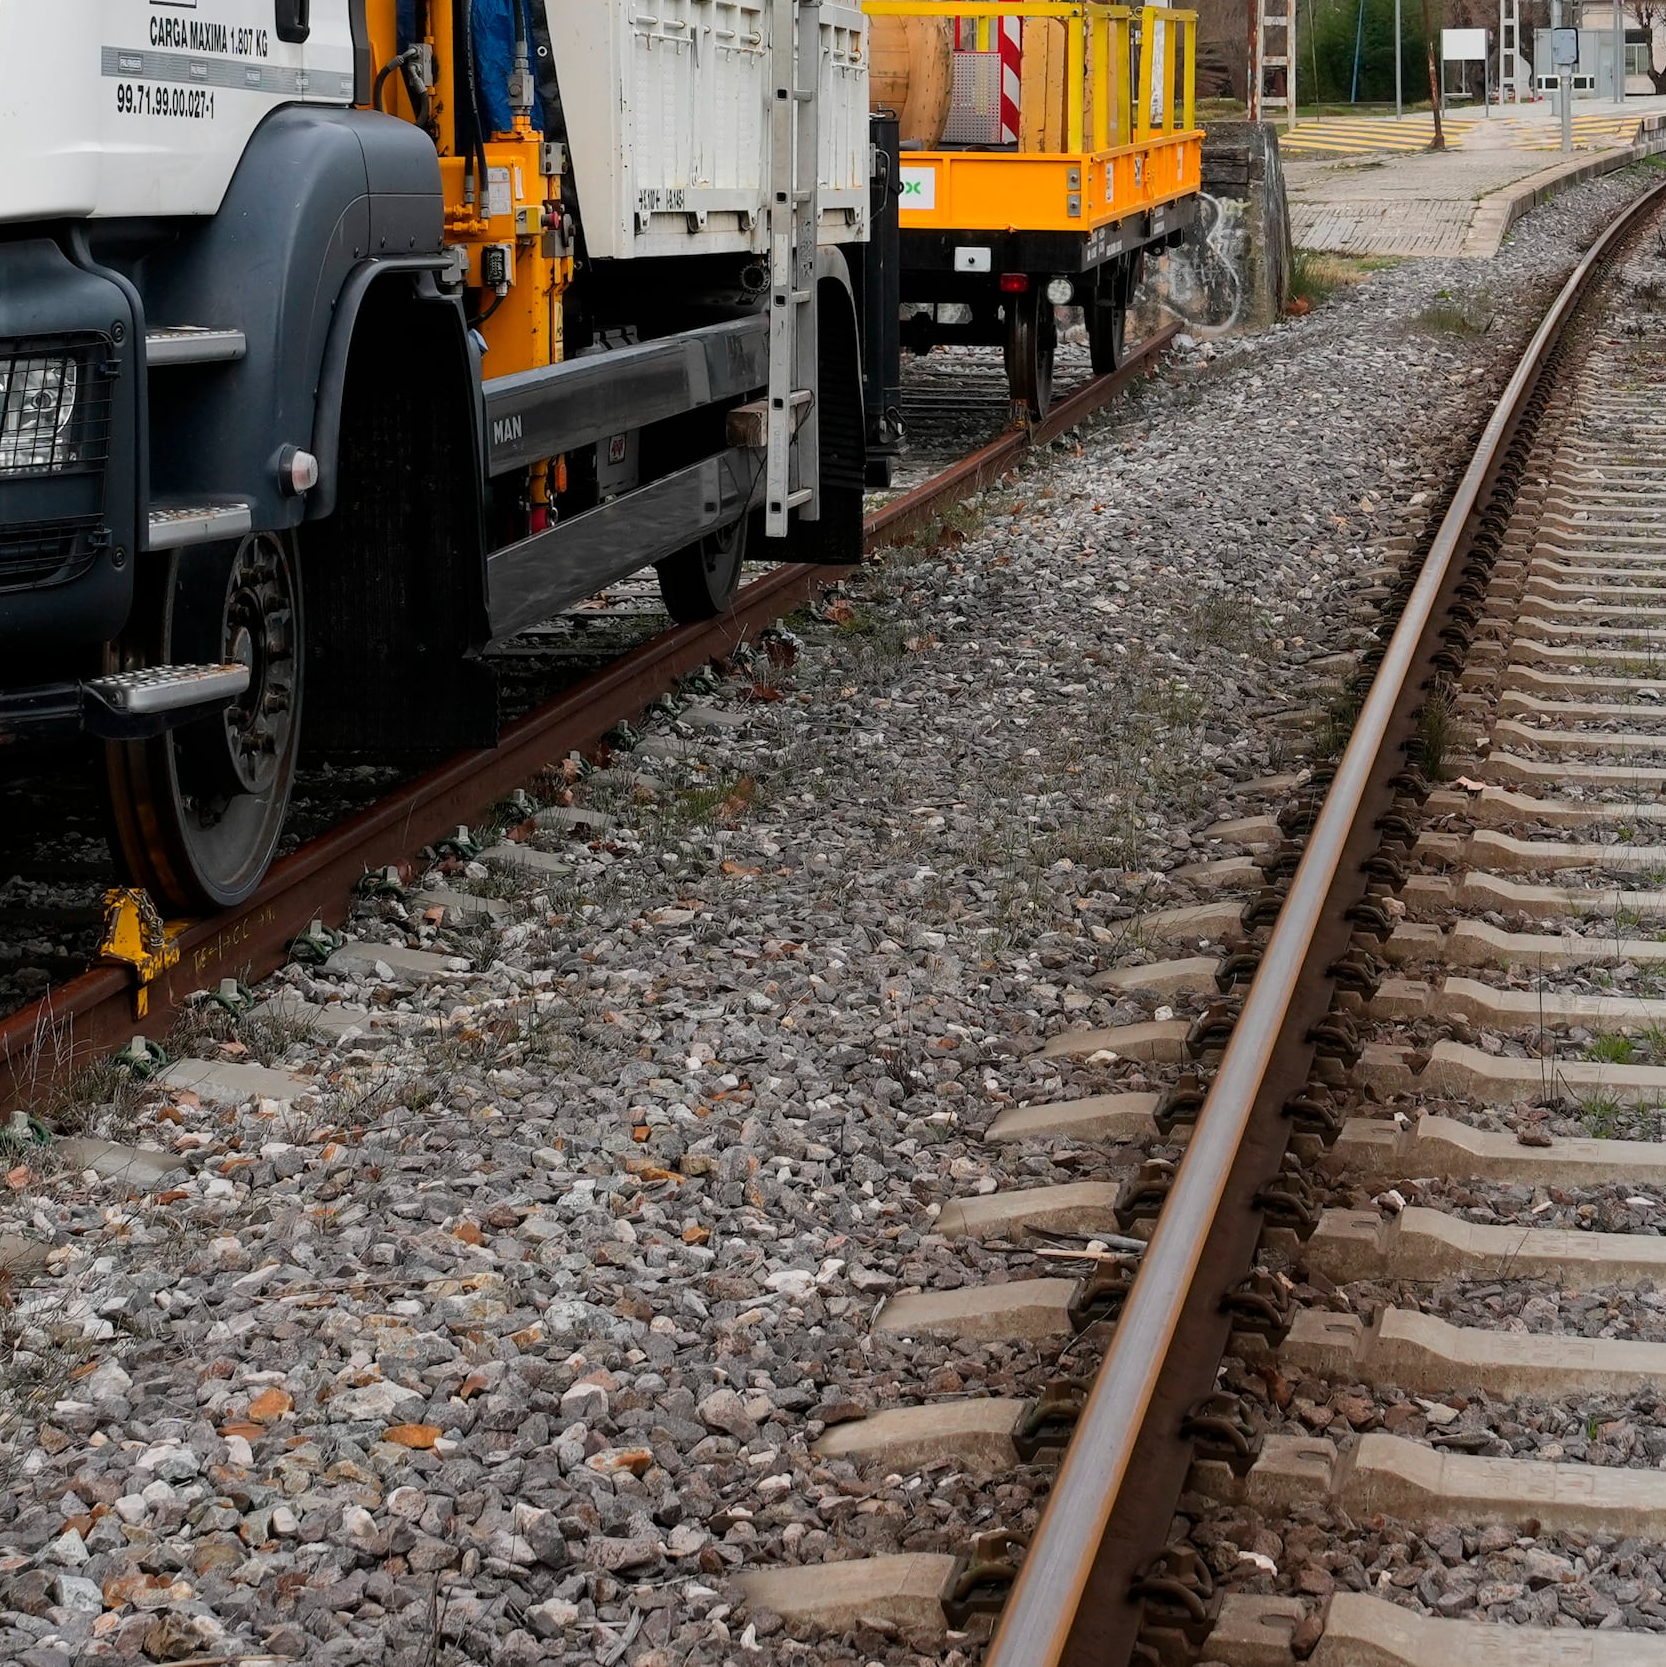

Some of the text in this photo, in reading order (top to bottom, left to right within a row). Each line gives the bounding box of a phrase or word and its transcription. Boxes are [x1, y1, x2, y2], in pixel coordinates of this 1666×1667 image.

[150, 16, 268, 57] CARGA MAXIMA 1.807 KG
[117, 83, 214, 119] 99.71.99.00.027-1
[493, 415, 522, 445] MAN
